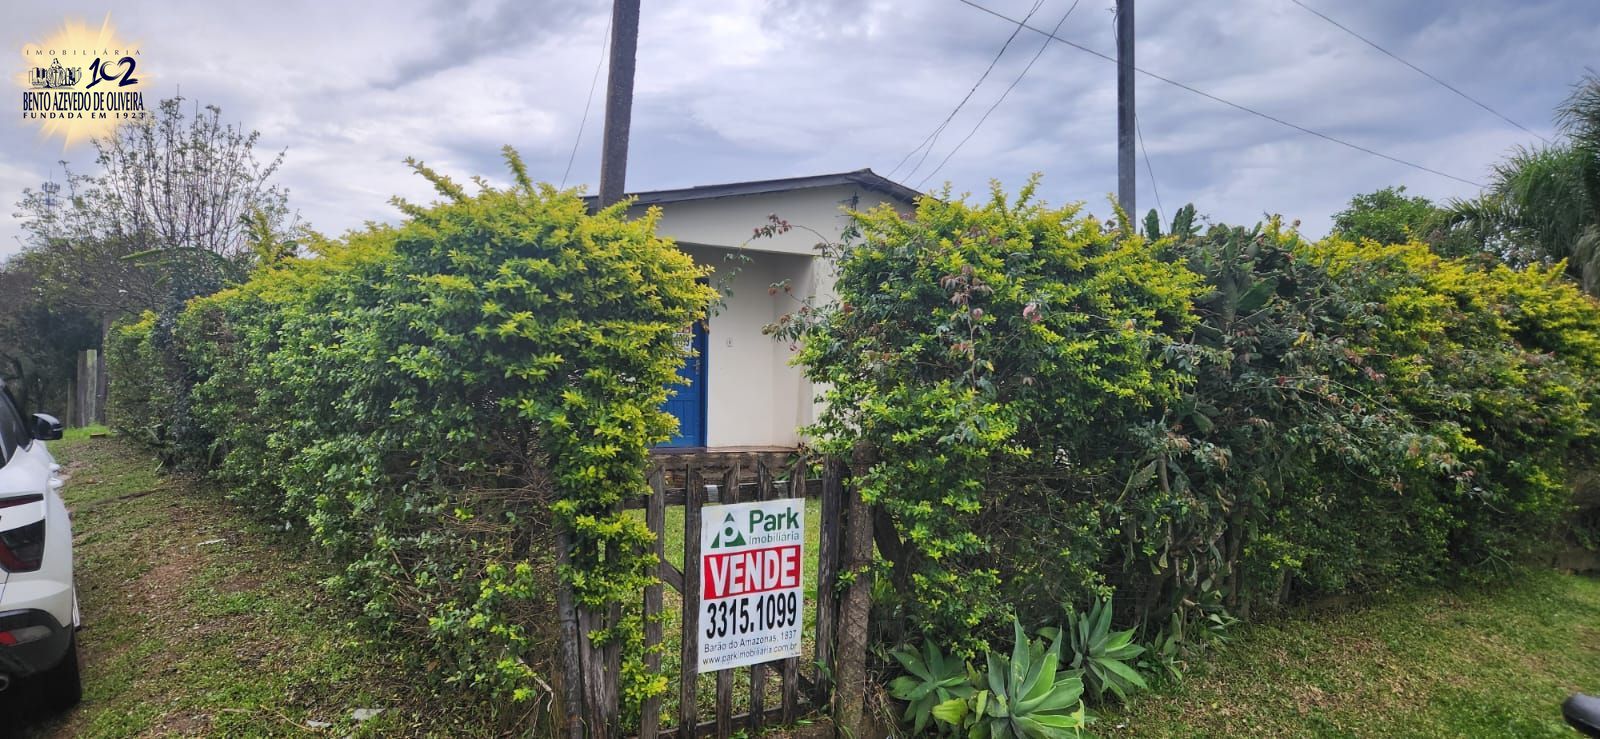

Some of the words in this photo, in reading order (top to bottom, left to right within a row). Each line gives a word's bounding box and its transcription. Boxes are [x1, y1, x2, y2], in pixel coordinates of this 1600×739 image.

[749, 507, 800, 534] Park
[749, 531, 800, 545] Imobiliária
[709, 547, 796, 597] VENDE
[706, 591, 797, 639] 3315.1099
[704, 641, 727, 653] Barão
[728, 640, 738, 649] do
